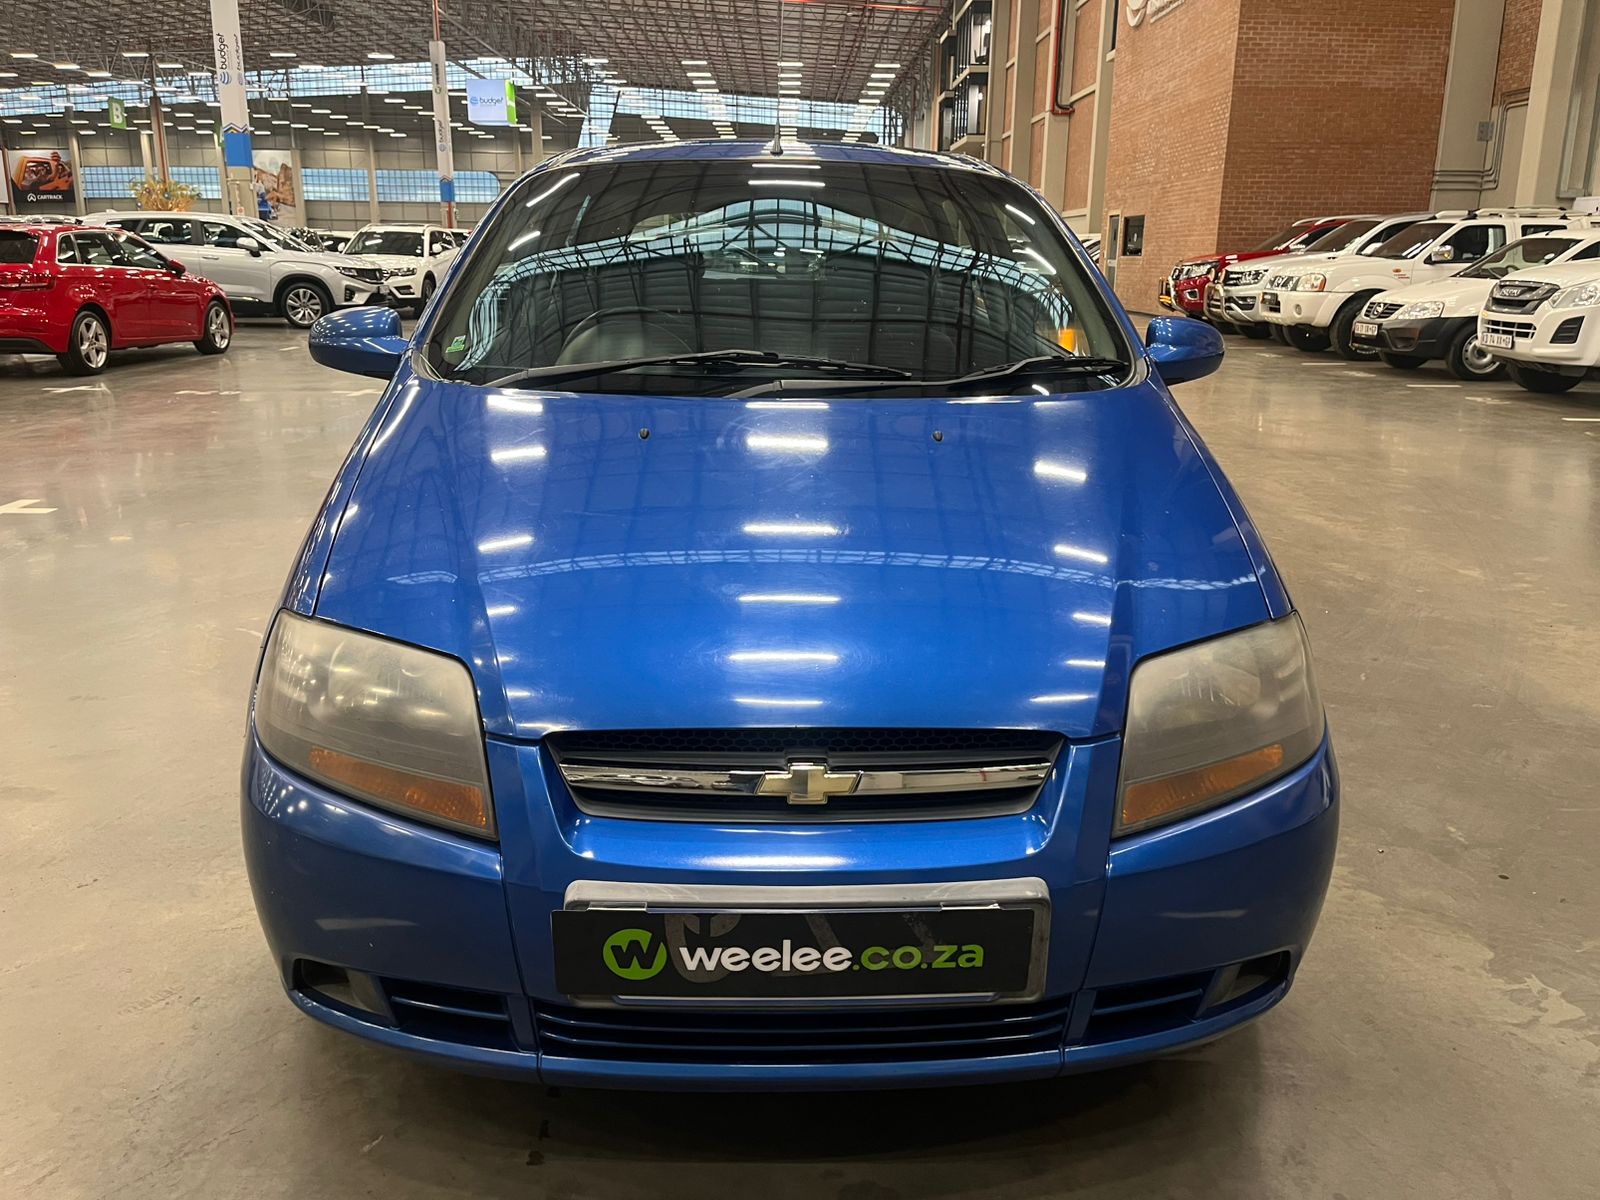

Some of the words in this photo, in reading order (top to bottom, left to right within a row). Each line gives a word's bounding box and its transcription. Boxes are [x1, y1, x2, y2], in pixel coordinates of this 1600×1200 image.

[216, 32, 228, 70] budget
[112, 103, 123, 124] B
[479, 96, 503, 105] budget
[679, 939, 985, 972] weelee.co.za
